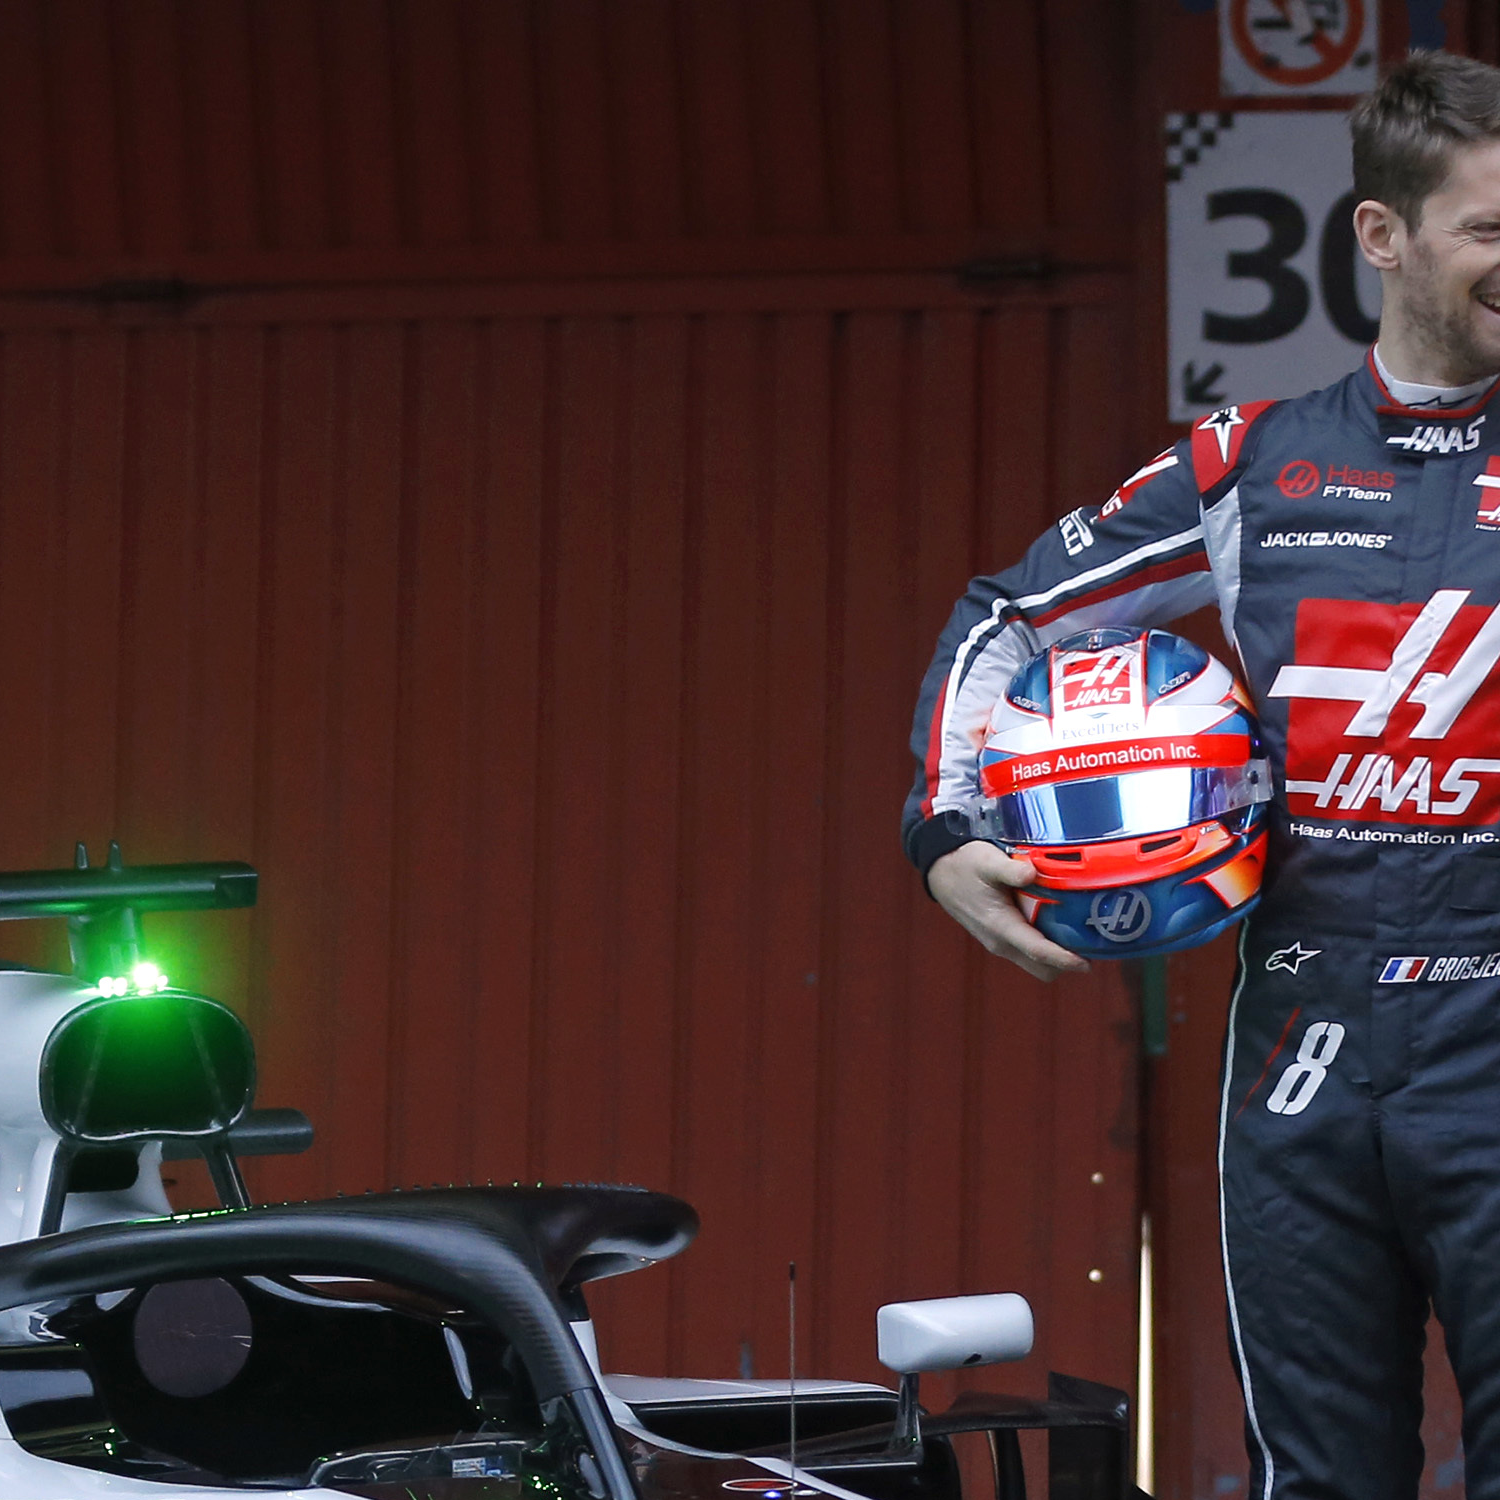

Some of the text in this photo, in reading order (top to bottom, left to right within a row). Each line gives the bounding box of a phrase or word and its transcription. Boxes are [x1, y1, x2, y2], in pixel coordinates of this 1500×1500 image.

[1386, 414, 1486, 453] HAAS
[1326, 464, 1396, 488] Haas
[1063, 687, 1130, 708] HAAS
[1012, 742, 1201, 782] Haas Automation Inc.
[1290, 823, 1500, 845] Haas Automation Inc.
[1266, 1020, 1347, 1116] 8
